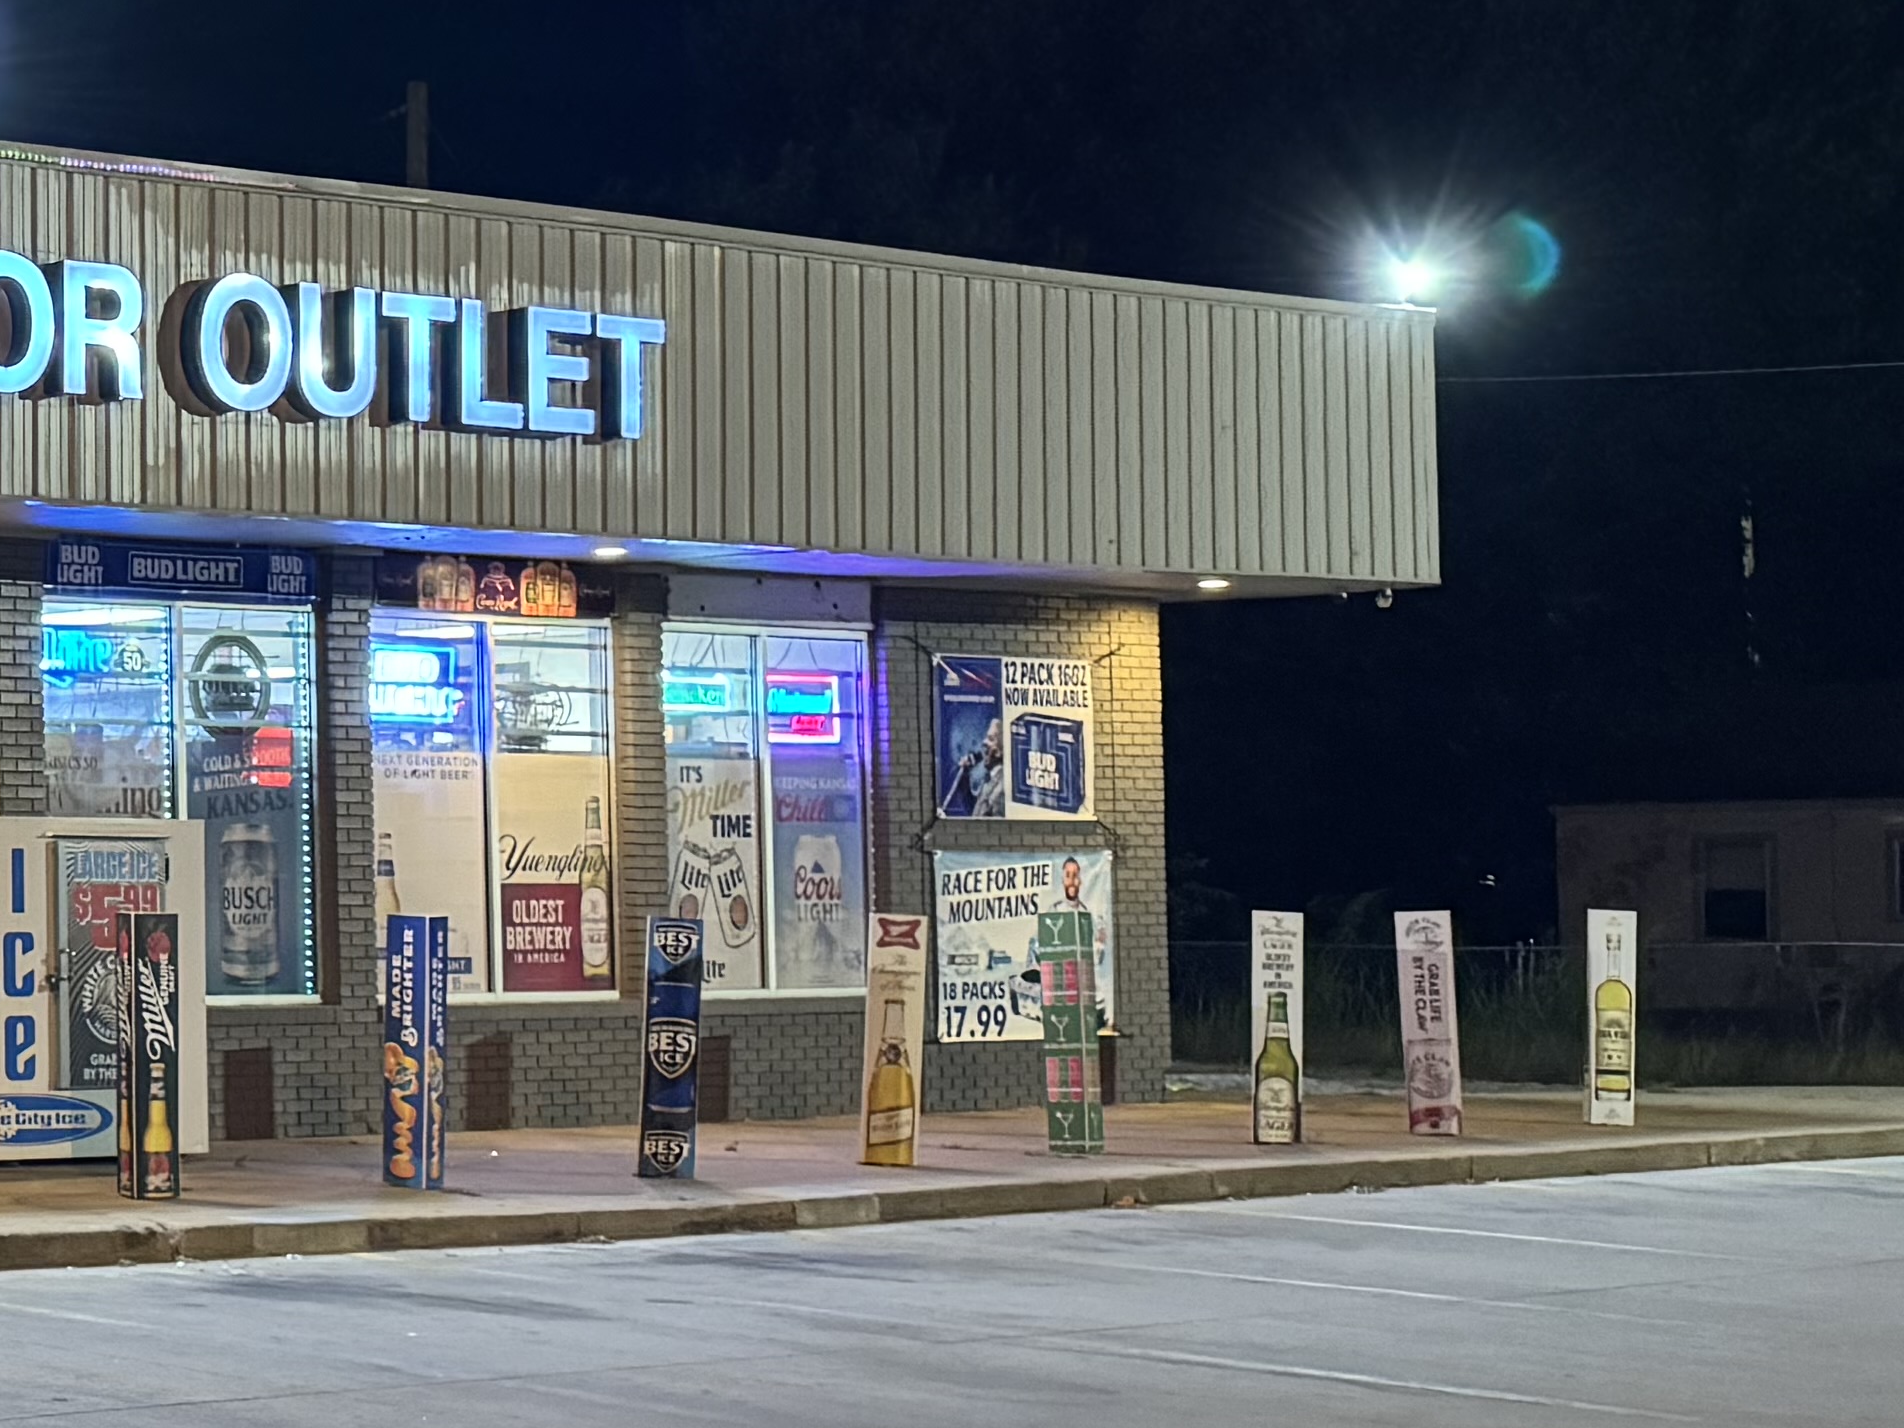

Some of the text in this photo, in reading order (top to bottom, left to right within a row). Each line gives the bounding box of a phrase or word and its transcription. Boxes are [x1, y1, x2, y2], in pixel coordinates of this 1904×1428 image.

[198, 271, 666, 440] OUTLET
[61, 545, 100, 563] BUD
[58, 563, 103, 584] LIGHT
[132, 558, 239, 583] BUD LIGHT
[271, 556, 303, 575] BUD
[267, 575, 306, 594] LIGHT
[1004, 661, 1019, 684] 12
[1021, 661, 1054, 686] PACK
[1005, 687, 1028, 706] NOW
[1032, 688, 1089, 708] AVAILABLE
[203, 756, 233, 772] COLD
[406, 754, 479, 767] GENERATION
[1028, 750, 1056, 772] BUD
[384, 767, 470, 780] OF LIGHT BEER
[679, 765, 703, 783] IT'S
[1025, 768, 1060, 791] LIGHT
[667, 778, 752, 832] Miller
[709, 814, 753, 838] TIME
[941, 863, 1050, 897] RACE FOR THE
[231, 911, 268, 926] LIGHT
[512, 898, 565, 924] OLDEST
[797, 902, 841, 922] LIGHT
[948, 893, 1040, 925] MOUNTAINS
[506, 925, 572, 951] BREWERY
[653, 930, 700, 949] BEST
[392, 955, 402, 1018] MADE
[400, 928, 419, 1047] BRIGHTER
[942, 981, 1006, 1001] 18 PACKS
[1413, 971, 1425, 996] THE
[1428, 963, 1442, 1023] GRAB LIFE
[138, 958, 176, 1061] Miller
[945, 1005, 1008, 1040] 17.99
[649, 1032, 697, 1054] BEST
[660, 1050, 684, 1064] ICE
[14, 1111, 51, 1129] City
[53, 1112, 87, 1126] Ice
[643, 1140, 691, 1156] BEST
